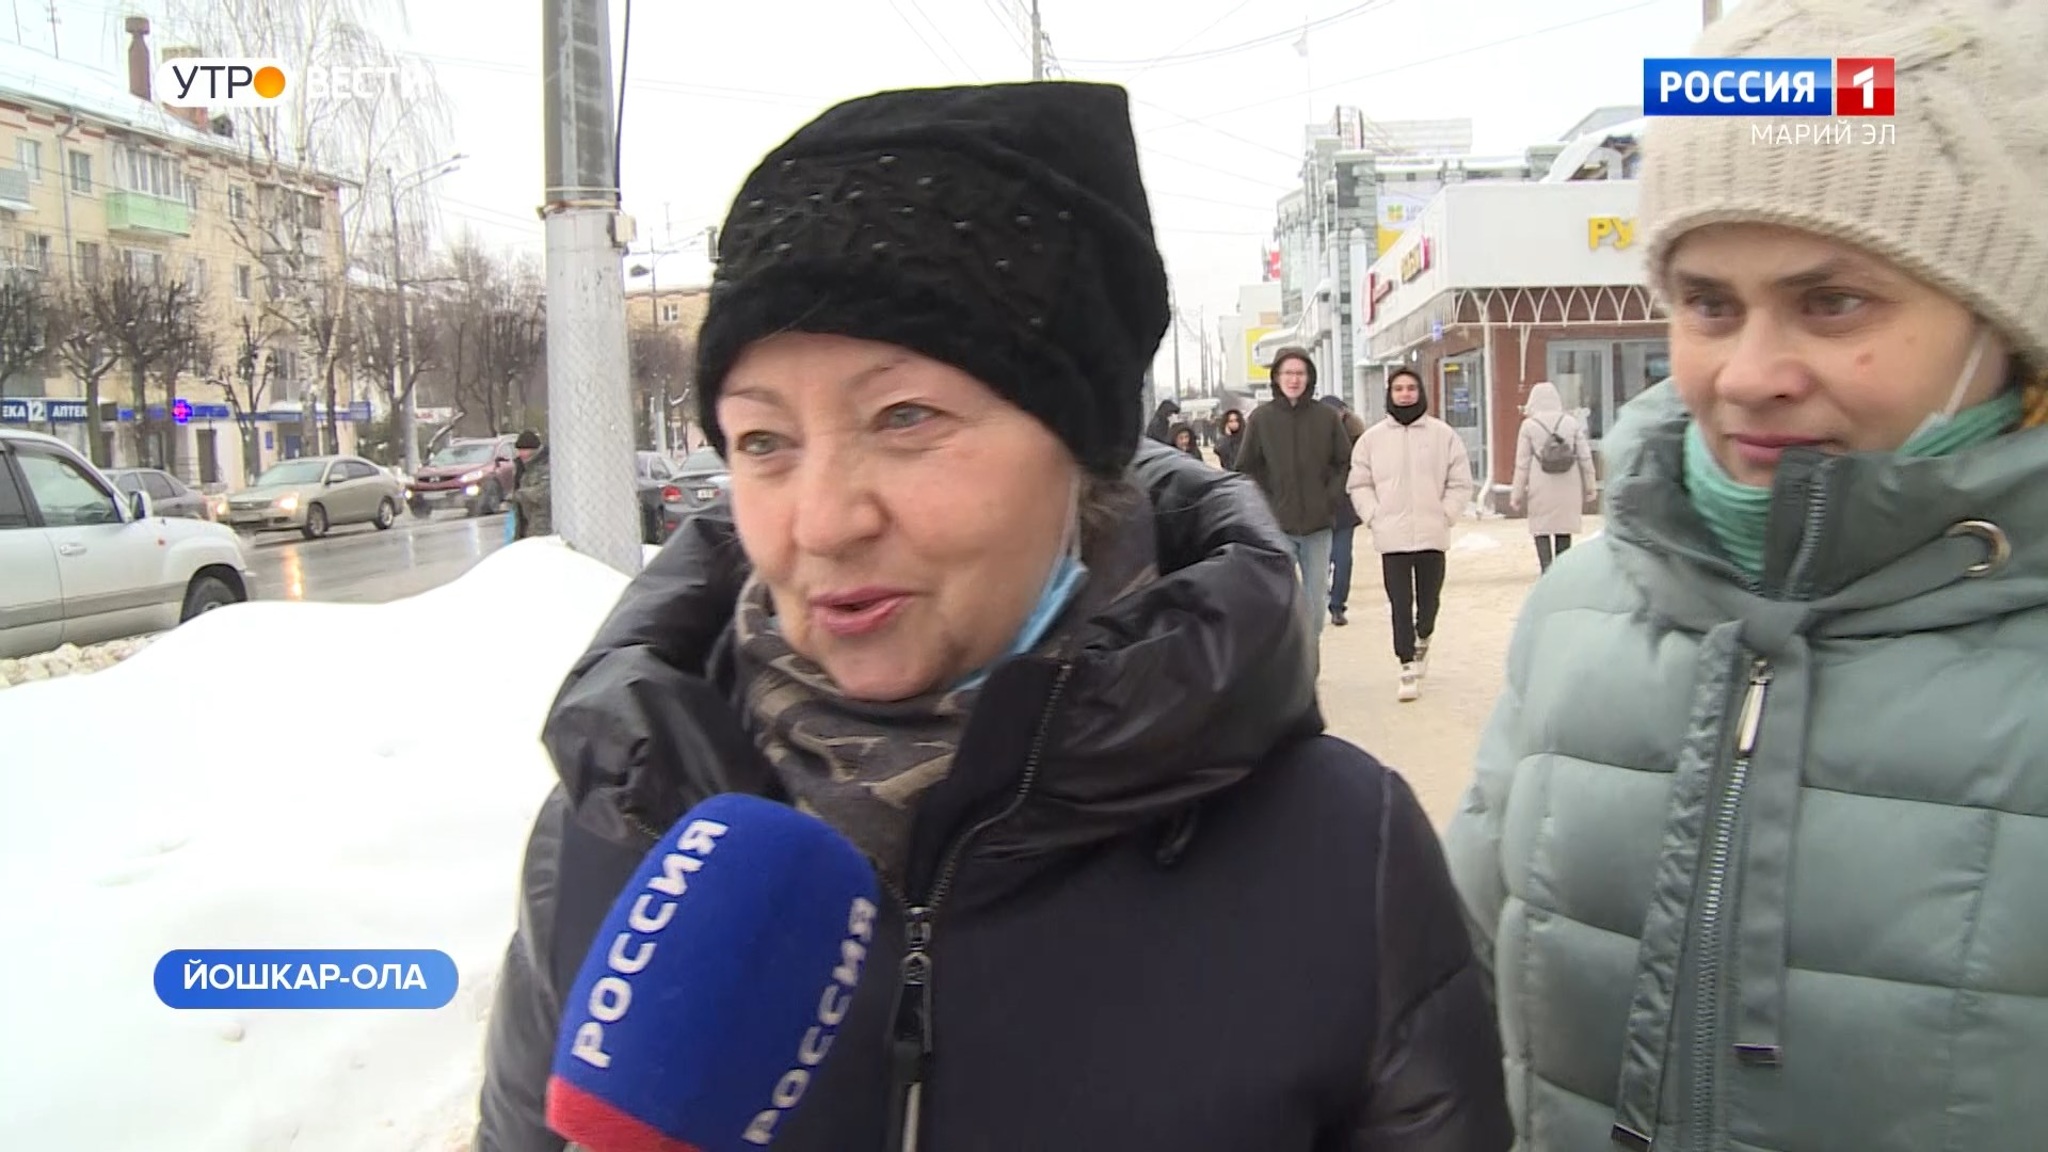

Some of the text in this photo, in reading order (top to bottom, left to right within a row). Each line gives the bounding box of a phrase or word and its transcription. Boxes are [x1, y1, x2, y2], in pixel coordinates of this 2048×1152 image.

[52, 404, 88, 418] АПТЕК
[571, 818, 730, 1069] РОССИЯ
[742, 896, 879, 1145] РОССИЯ
